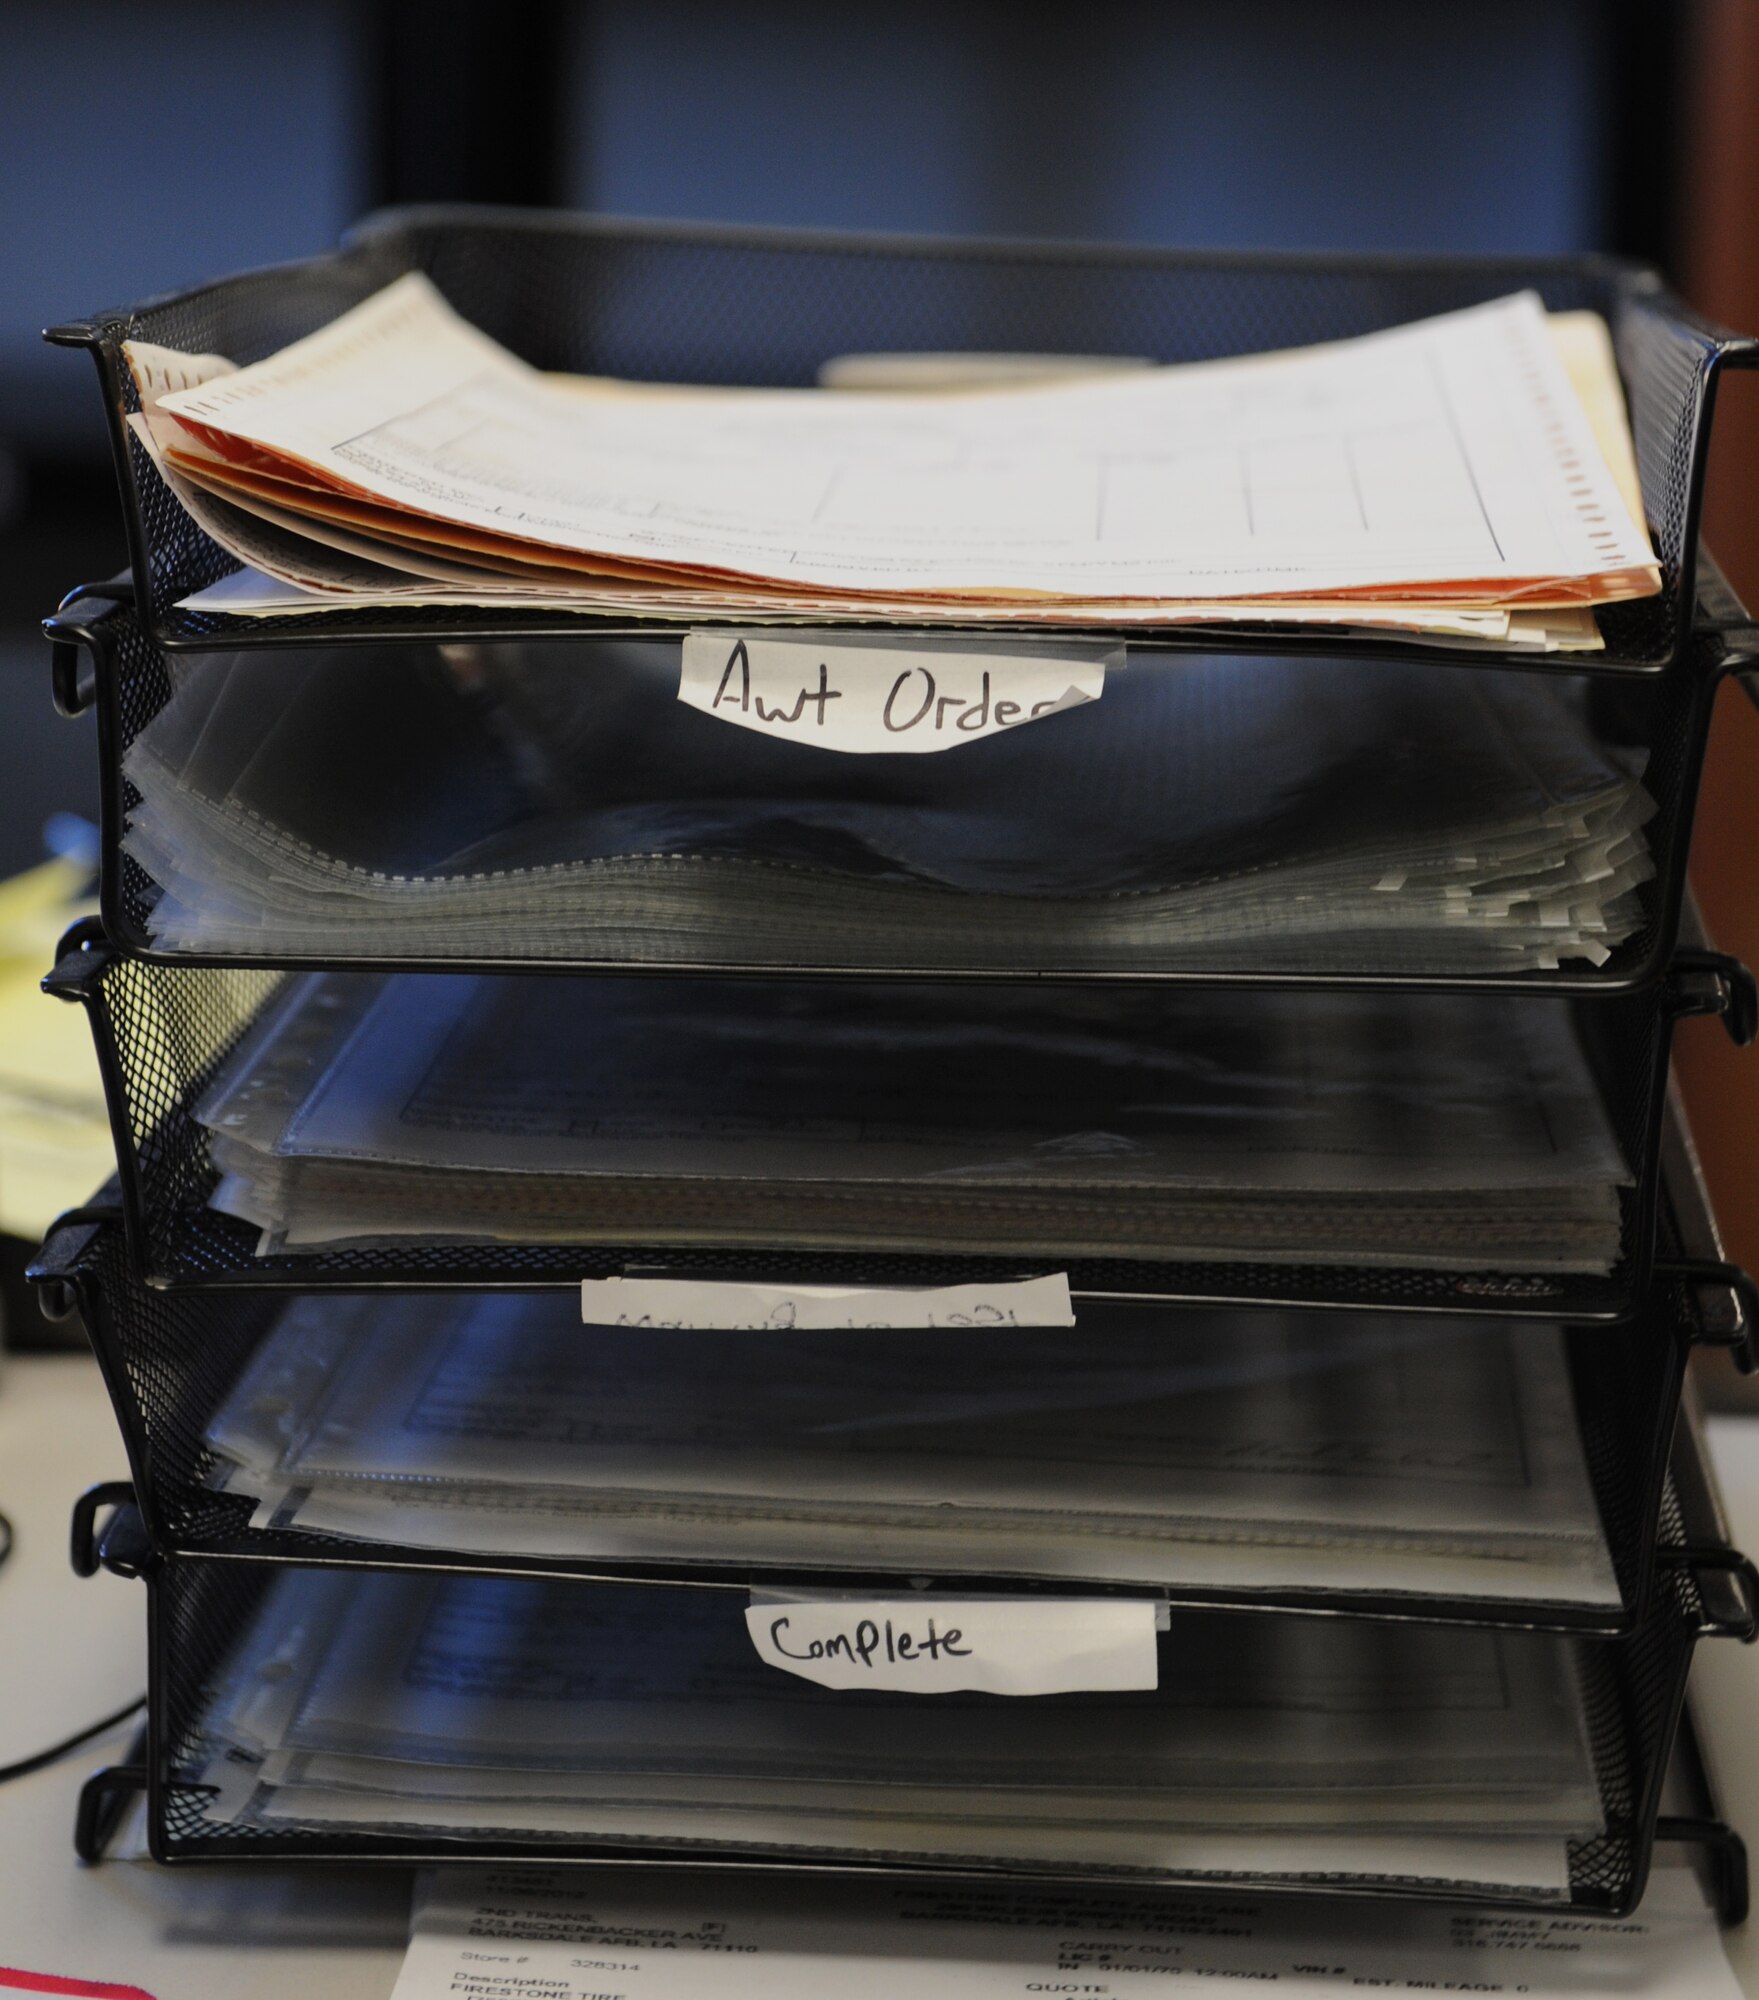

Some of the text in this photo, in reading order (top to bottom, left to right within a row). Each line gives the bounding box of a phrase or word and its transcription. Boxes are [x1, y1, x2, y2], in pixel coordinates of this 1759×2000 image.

[712, 639, 842, 725] Awt
[770, 1617, 973, 1668] Complete
[474, 1906, 518, 1918] 2ND
[468, 1926, 593, 1944] BARKSDALE
[700, 1942, 759, 1954] 71110
[1059, 1940, 1184, 1955] CARRY OUT
[460, 1951, 511, 1964] Store
[516, 1956, 530, 1964] #
[1058, 1952, 1093, 1962] LIC
[1058, 1962, 1080, 1971] IN
[453, 1971, 571, 1989] Description
[450, 1982, 573, 2000] FIRESTONE
[1026, 1982, 1109, 1994] QUOTE
